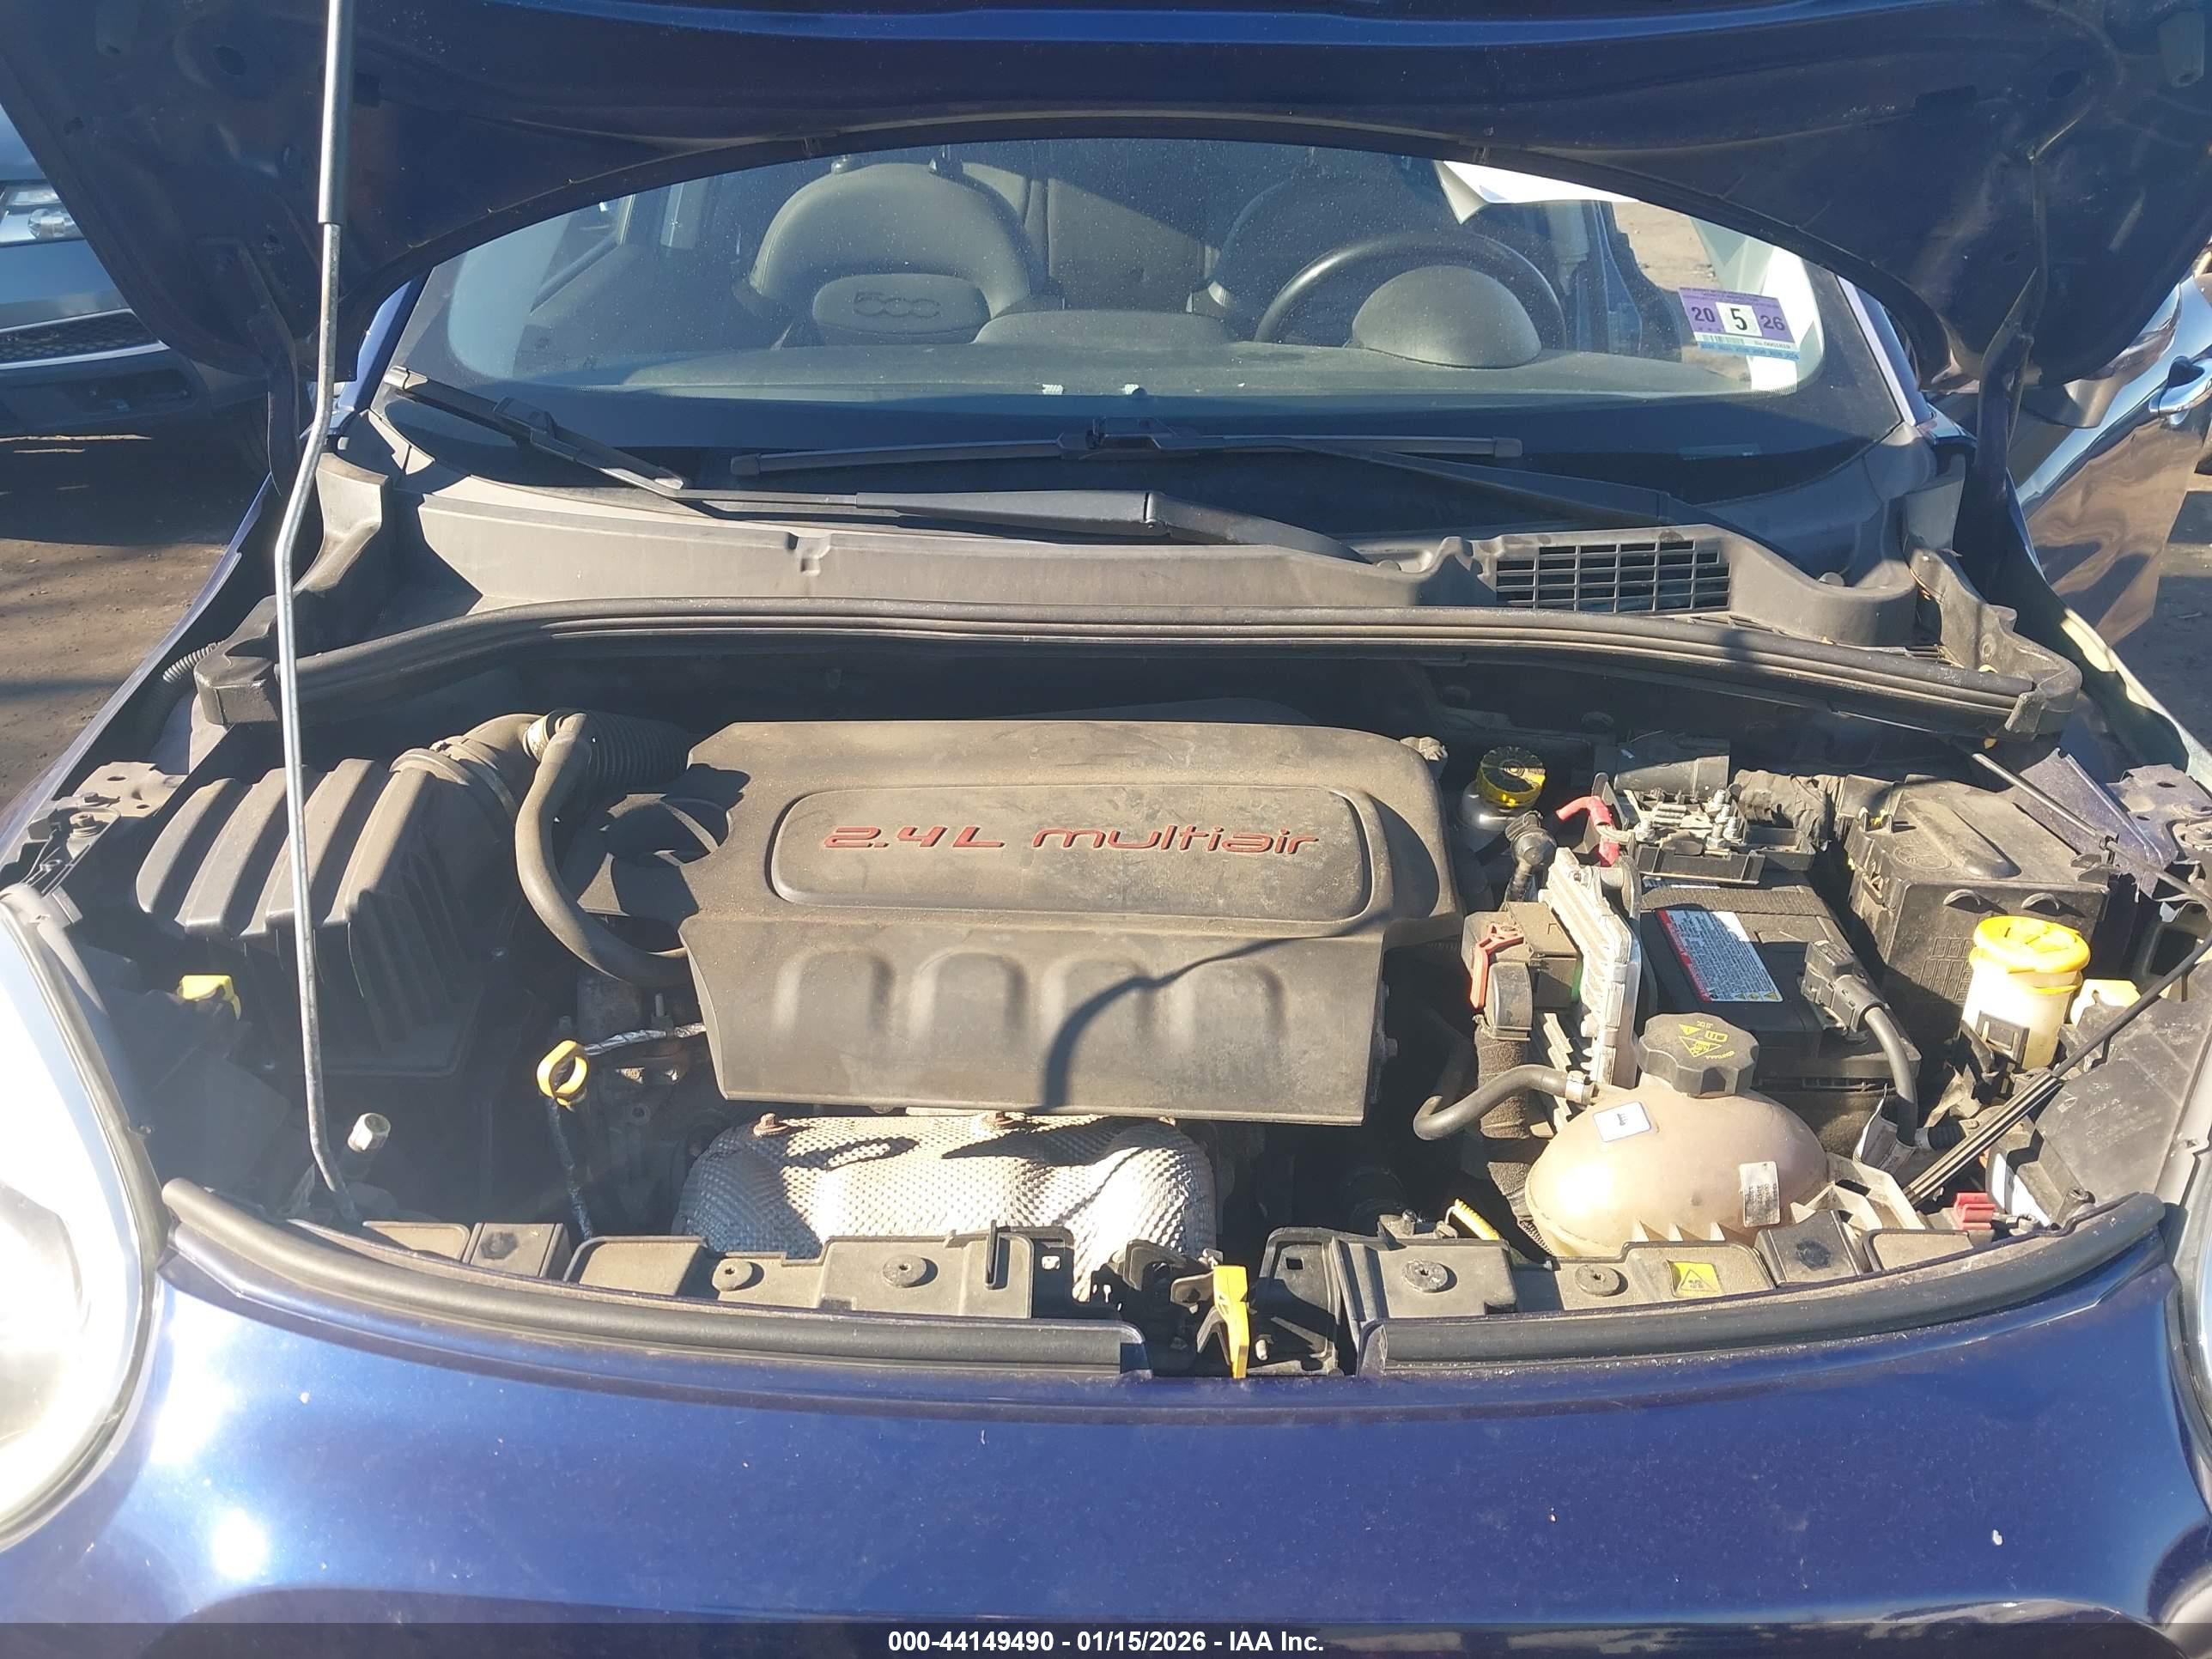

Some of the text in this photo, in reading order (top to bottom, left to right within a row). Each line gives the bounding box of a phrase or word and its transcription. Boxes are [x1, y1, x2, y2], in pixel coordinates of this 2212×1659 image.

[1691, 307, 1785, 331] 20 5 26
[823, 824, 1319, 854] 2.4L multiair
